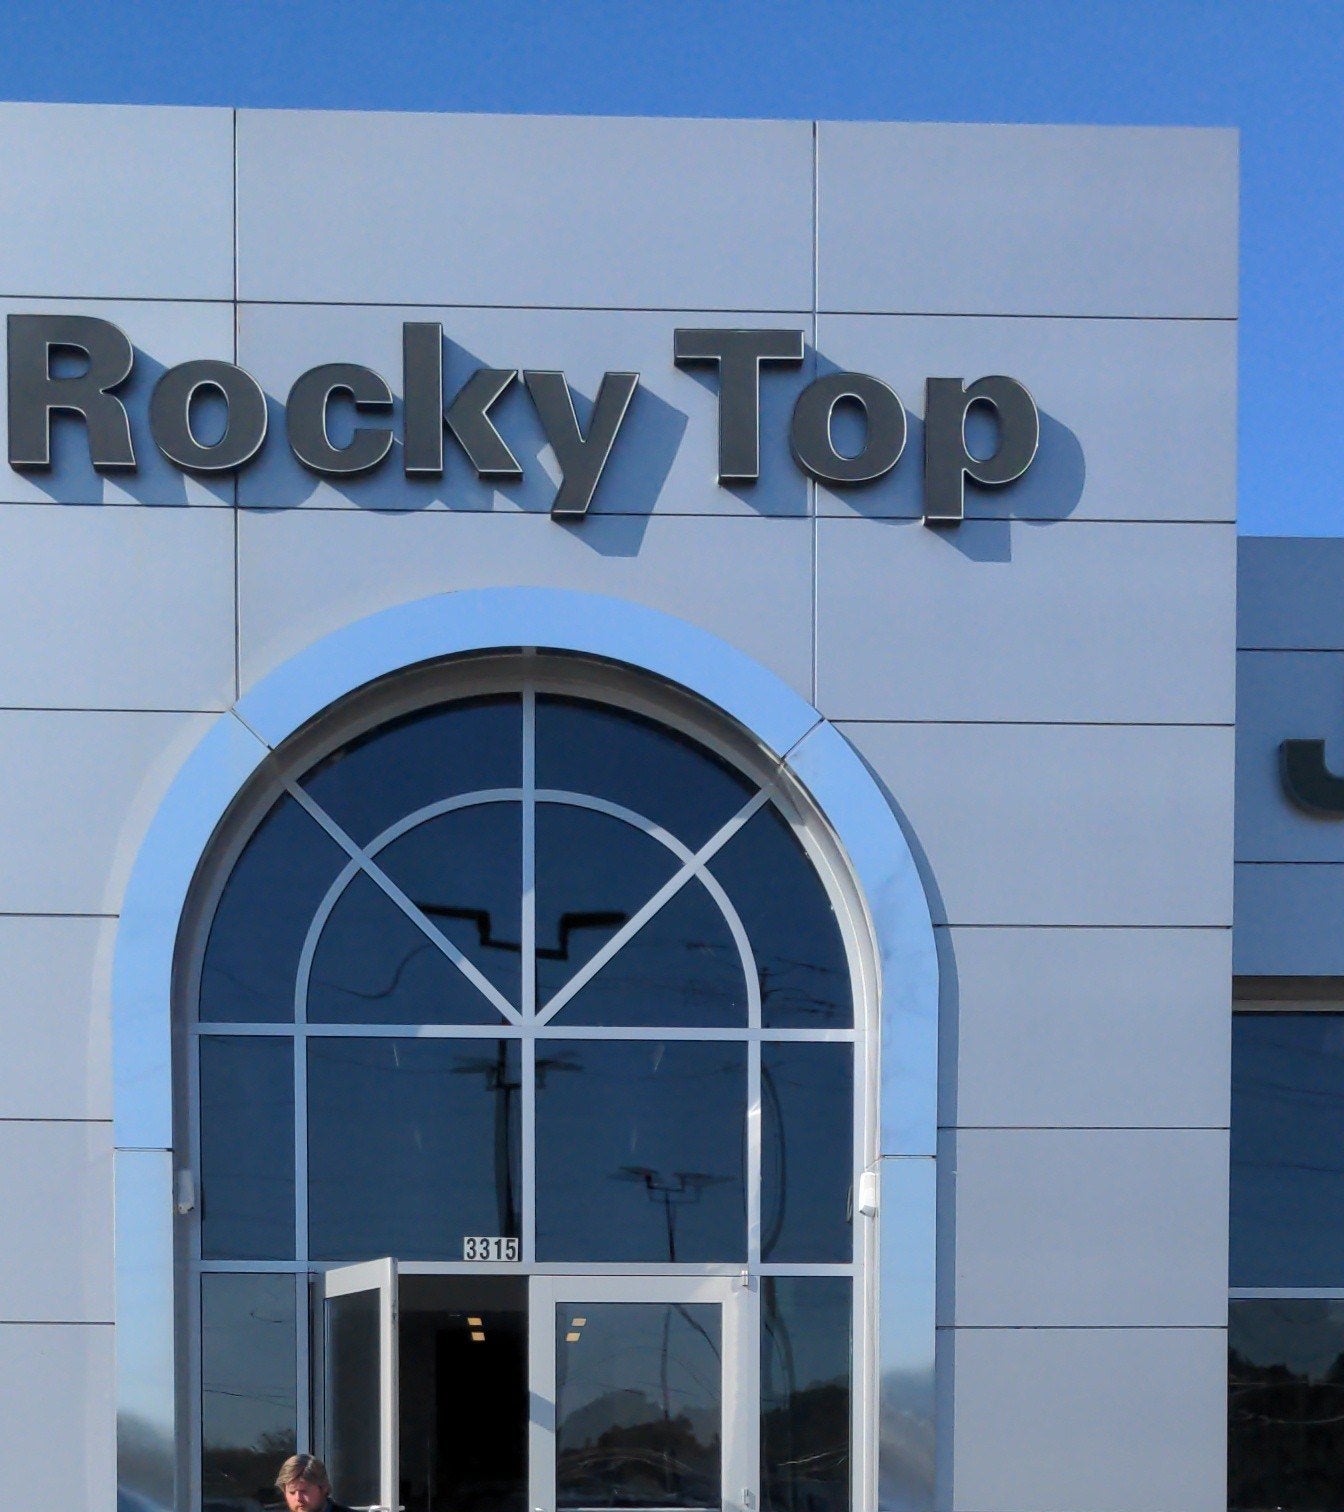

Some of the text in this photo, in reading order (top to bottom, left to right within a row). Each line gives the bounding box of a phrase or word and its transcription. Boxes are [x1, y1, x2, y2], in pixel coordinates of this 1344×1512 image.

[6, 313, 1041, 526] Rocky Top
[466, 1237, 517, 1261] 3315
